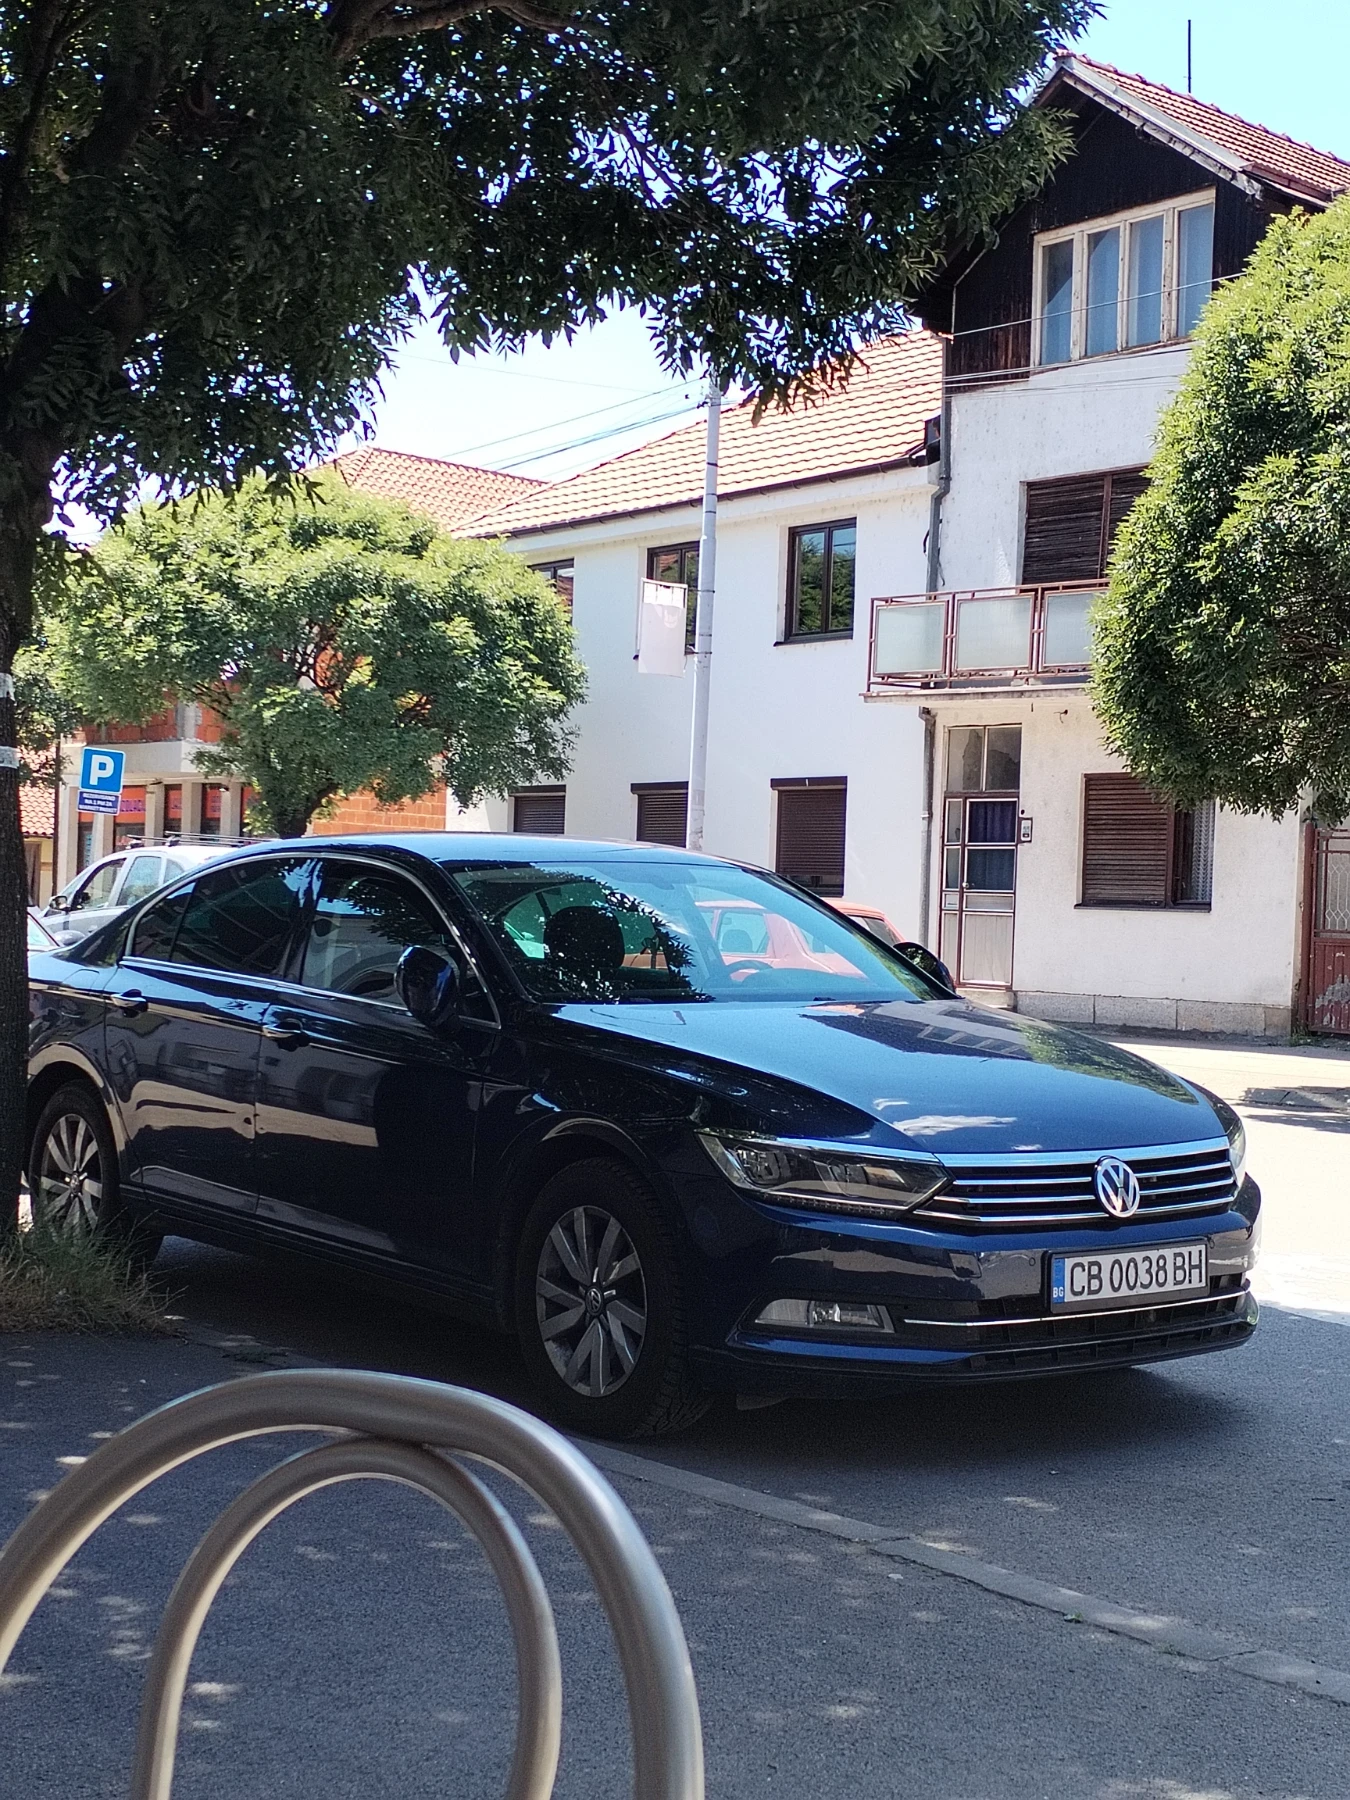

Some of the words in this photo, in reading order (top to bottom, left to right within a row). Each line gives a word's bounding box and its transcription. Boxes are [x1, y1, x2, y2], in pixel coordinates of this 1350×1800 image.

[90, 755, 114, 786] P
[1070, 1260, 1103, 1297] CB
[1110, 1254, 1168, 1293] 0038
[1173, 1249, 1203, 1286] BH
[1053, 1286, 1064, 1297] BG
